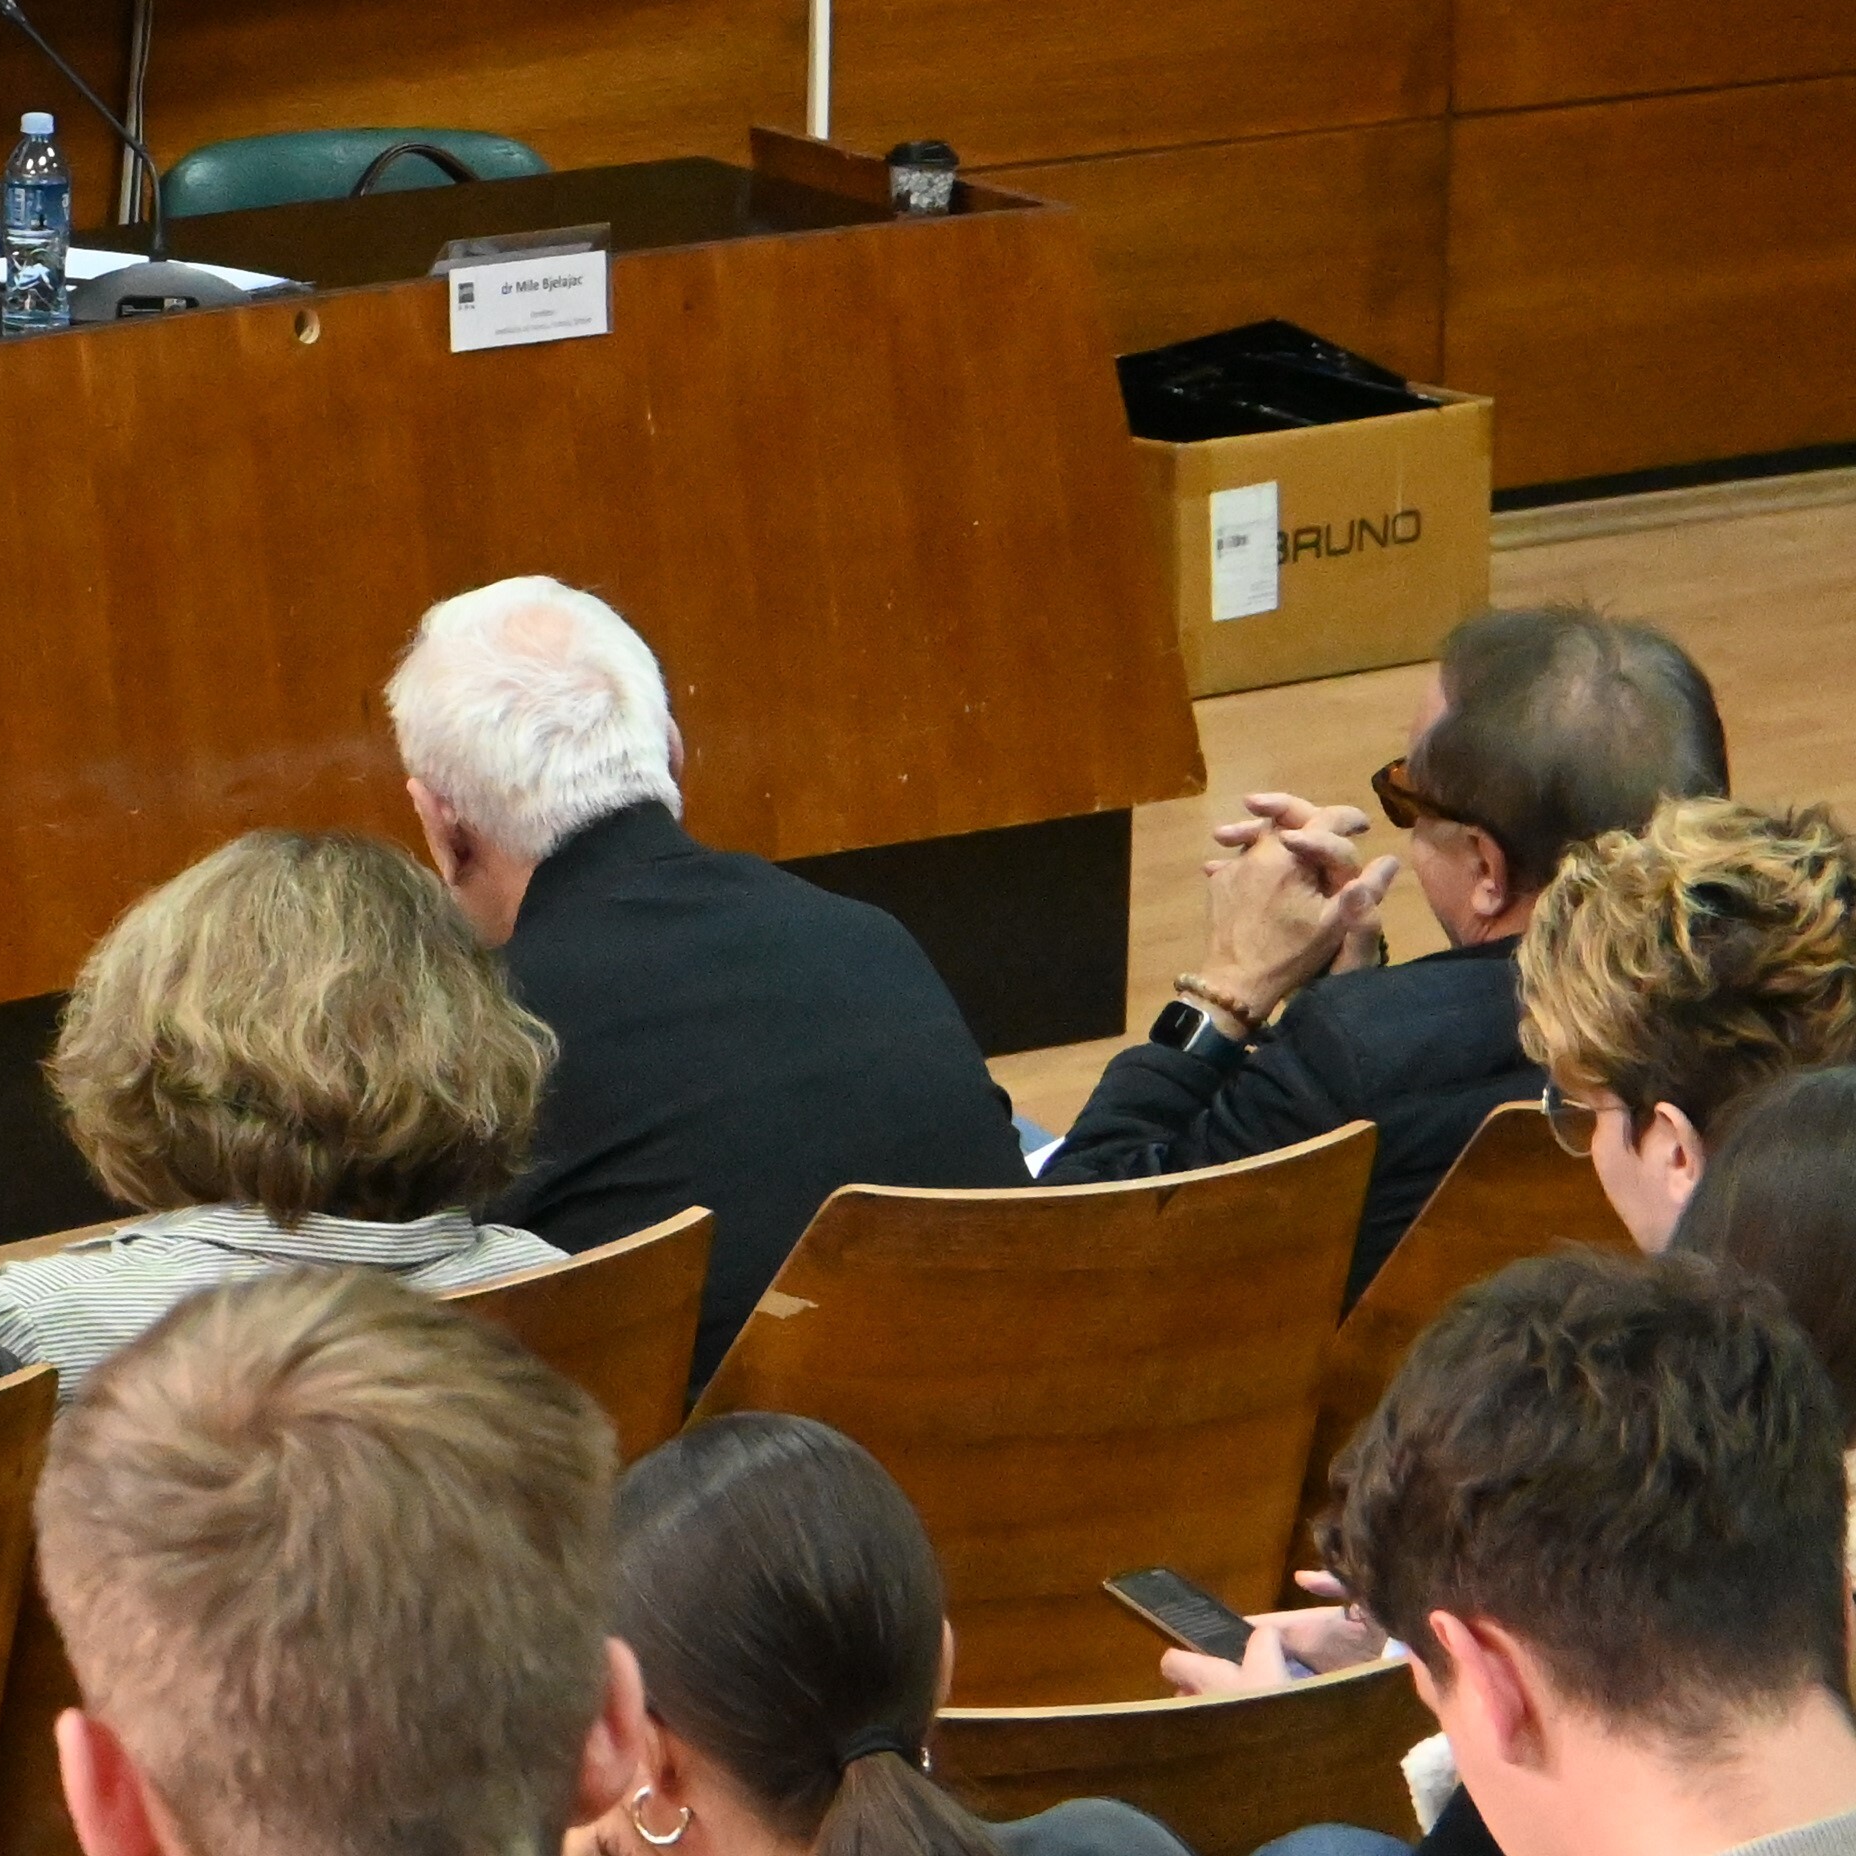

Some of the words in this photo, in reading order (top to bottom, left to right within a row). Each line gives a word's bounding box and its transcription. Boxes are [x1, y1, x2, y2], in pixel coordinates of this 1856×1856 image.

[501, 282, 512, 294] dr
[516, 280, 539, 293] Mile
[542, 274, 583, 293] Bjelajac
